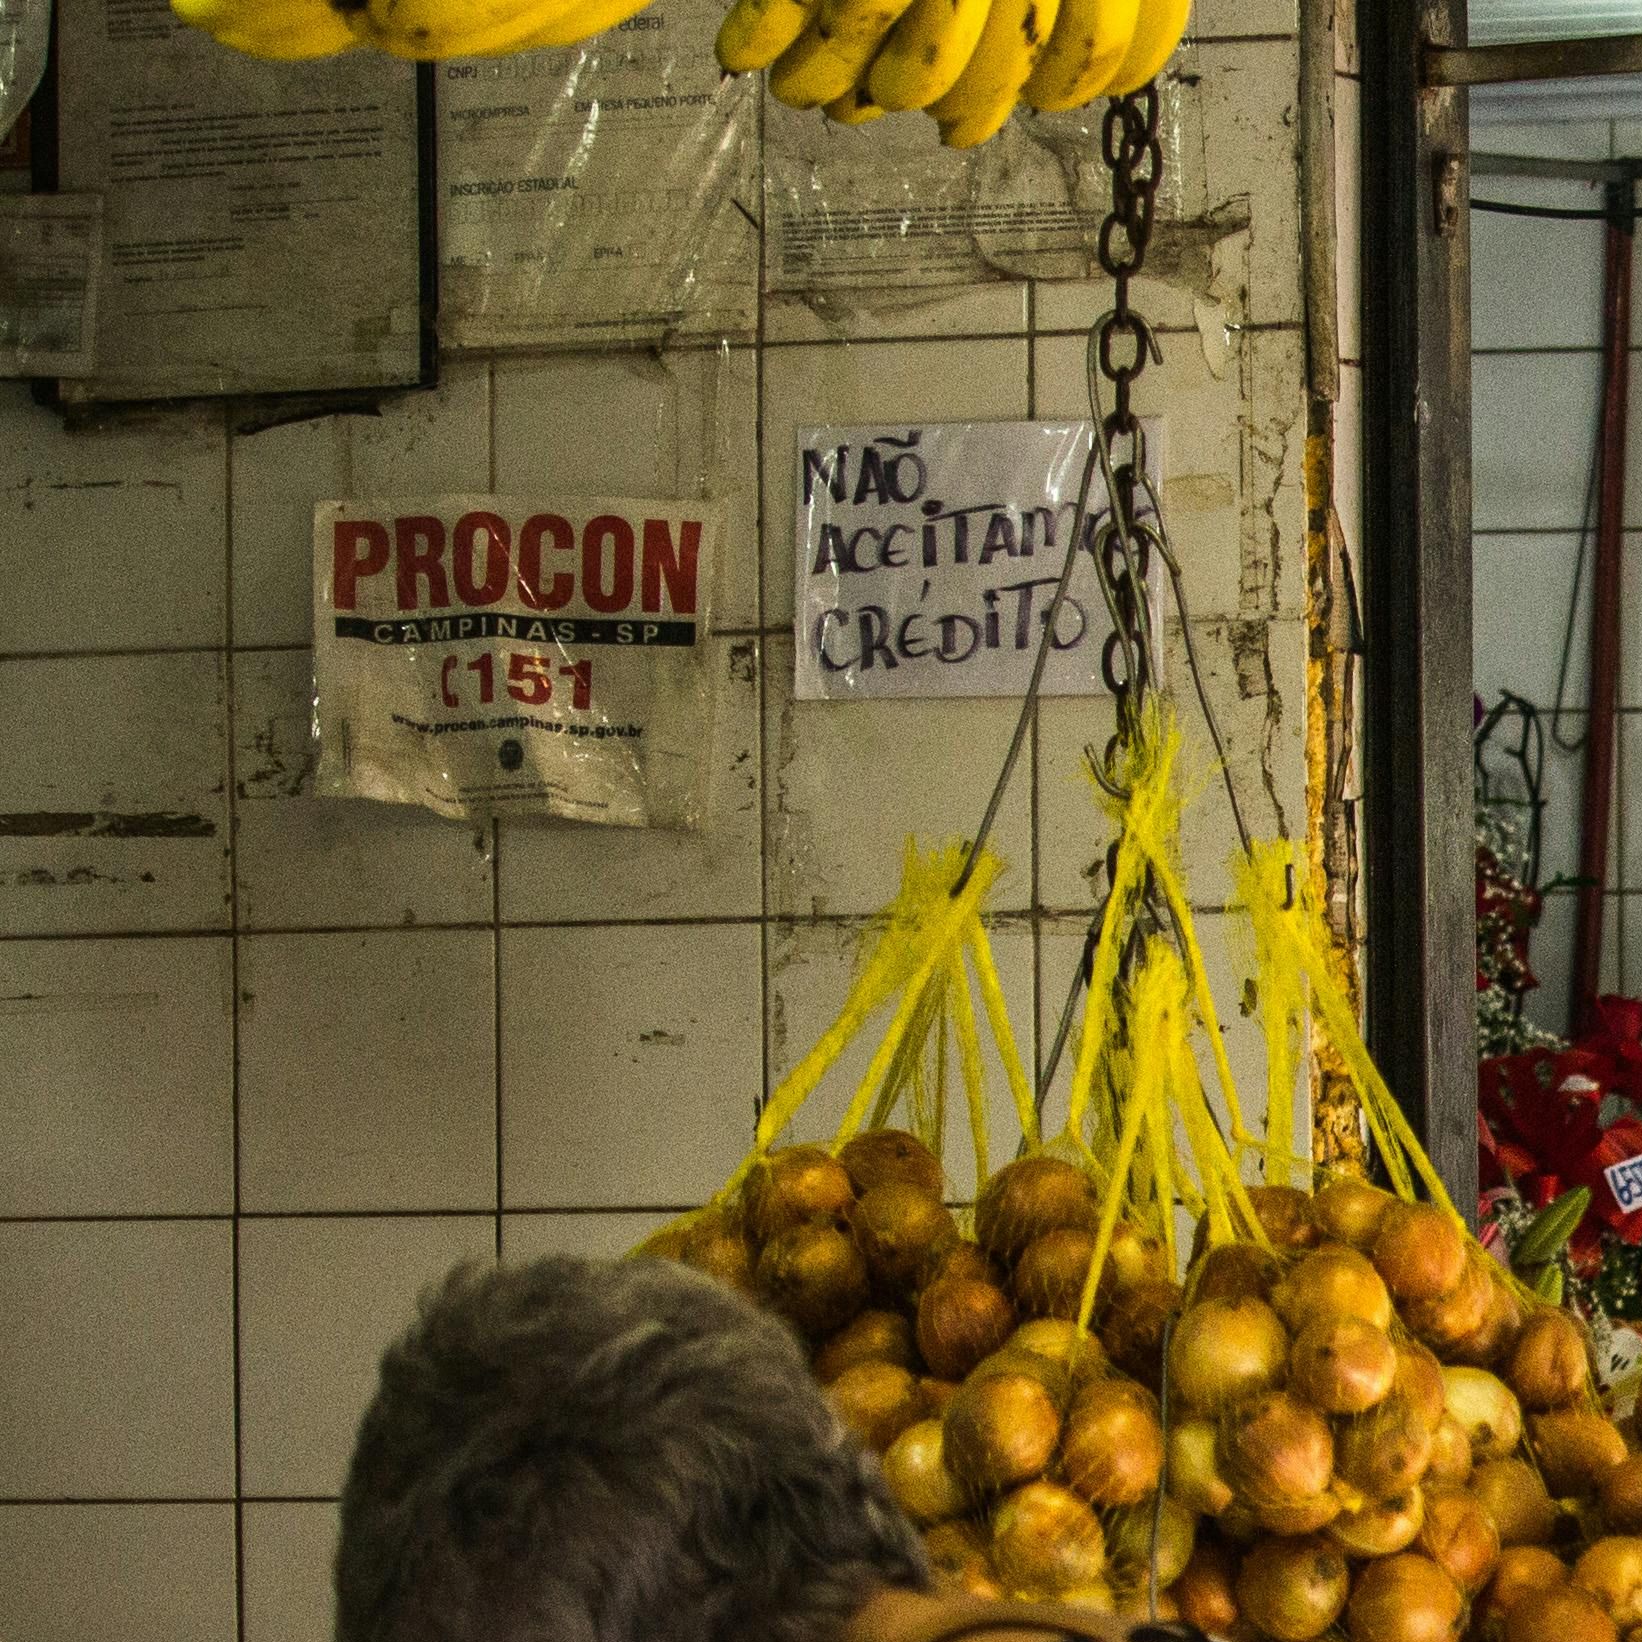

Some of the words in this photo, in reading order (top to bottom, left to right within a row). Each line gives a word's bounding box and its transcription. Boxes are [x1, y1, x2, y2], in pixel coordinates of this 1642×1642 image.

[448, 66, 478, 79] CNPJ
[803, 429, 927, 505] NÃO
[333, 510, 702, 614] PROCON
[373, 615, 576, 644] CAMPINAS
[616, 623, 660, 644] SP
[466, 652, 593, 710] 151
[391, 713, 644, 739] www.procon.campinas.sp.gov.br
